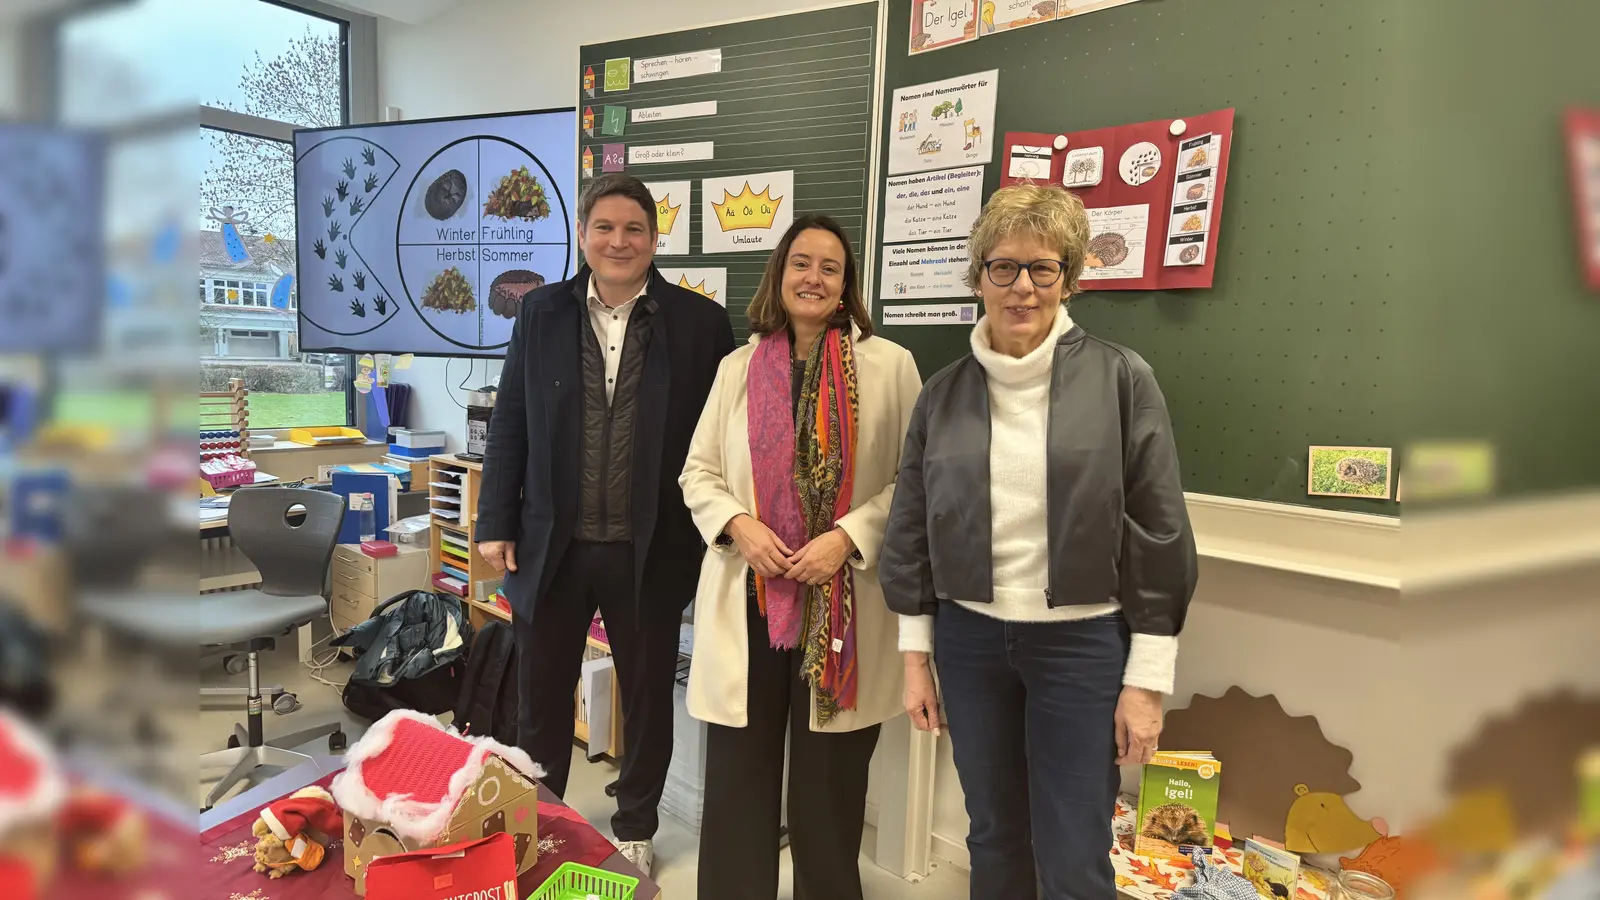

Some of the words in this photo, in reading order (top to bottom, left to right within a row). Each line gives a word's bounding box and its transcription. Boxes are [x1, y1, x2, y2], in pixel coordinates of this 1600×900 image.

[925, 12, 944, 28] Der
[948, 2, 967, 28] Igel
[641, 60, 667, 70] Sprechen
[675, 56, 692, 64] hören
[641, 71, 669, 79] schwingen
[900, 93, 921, 101] Nomen
[935, 82, 977, 95] Namenwörter
[978, 80, 988, 88] für
[637, 111, 662, 119] Ableiten
[635, 151, 649, 160] Groß
[666, 148, 685, 157] klein?
[926, 174, 946, 182] Artikel
[947, 170, 981, 181] (Begleiter):
[659, 206, 669, 215] Oo
[726, 207, 735, 217] Ää
[743, 206, 753, 216] Öö
[760, 204, 771, 215] Üü
[436, 228, 475, 241] Winter
[482, 226, 533, 243] Frühling
[732, 235, 763, 244] Umlaute
[436, 248, 475, 261] Herbst
[482, 248, 533, 261] Sommer
[921, 257, 947, 265] Mehrzahl
[1168, 778, 1191, 789] Hallo,
[1165, 786, 1193, 799] Igel!
